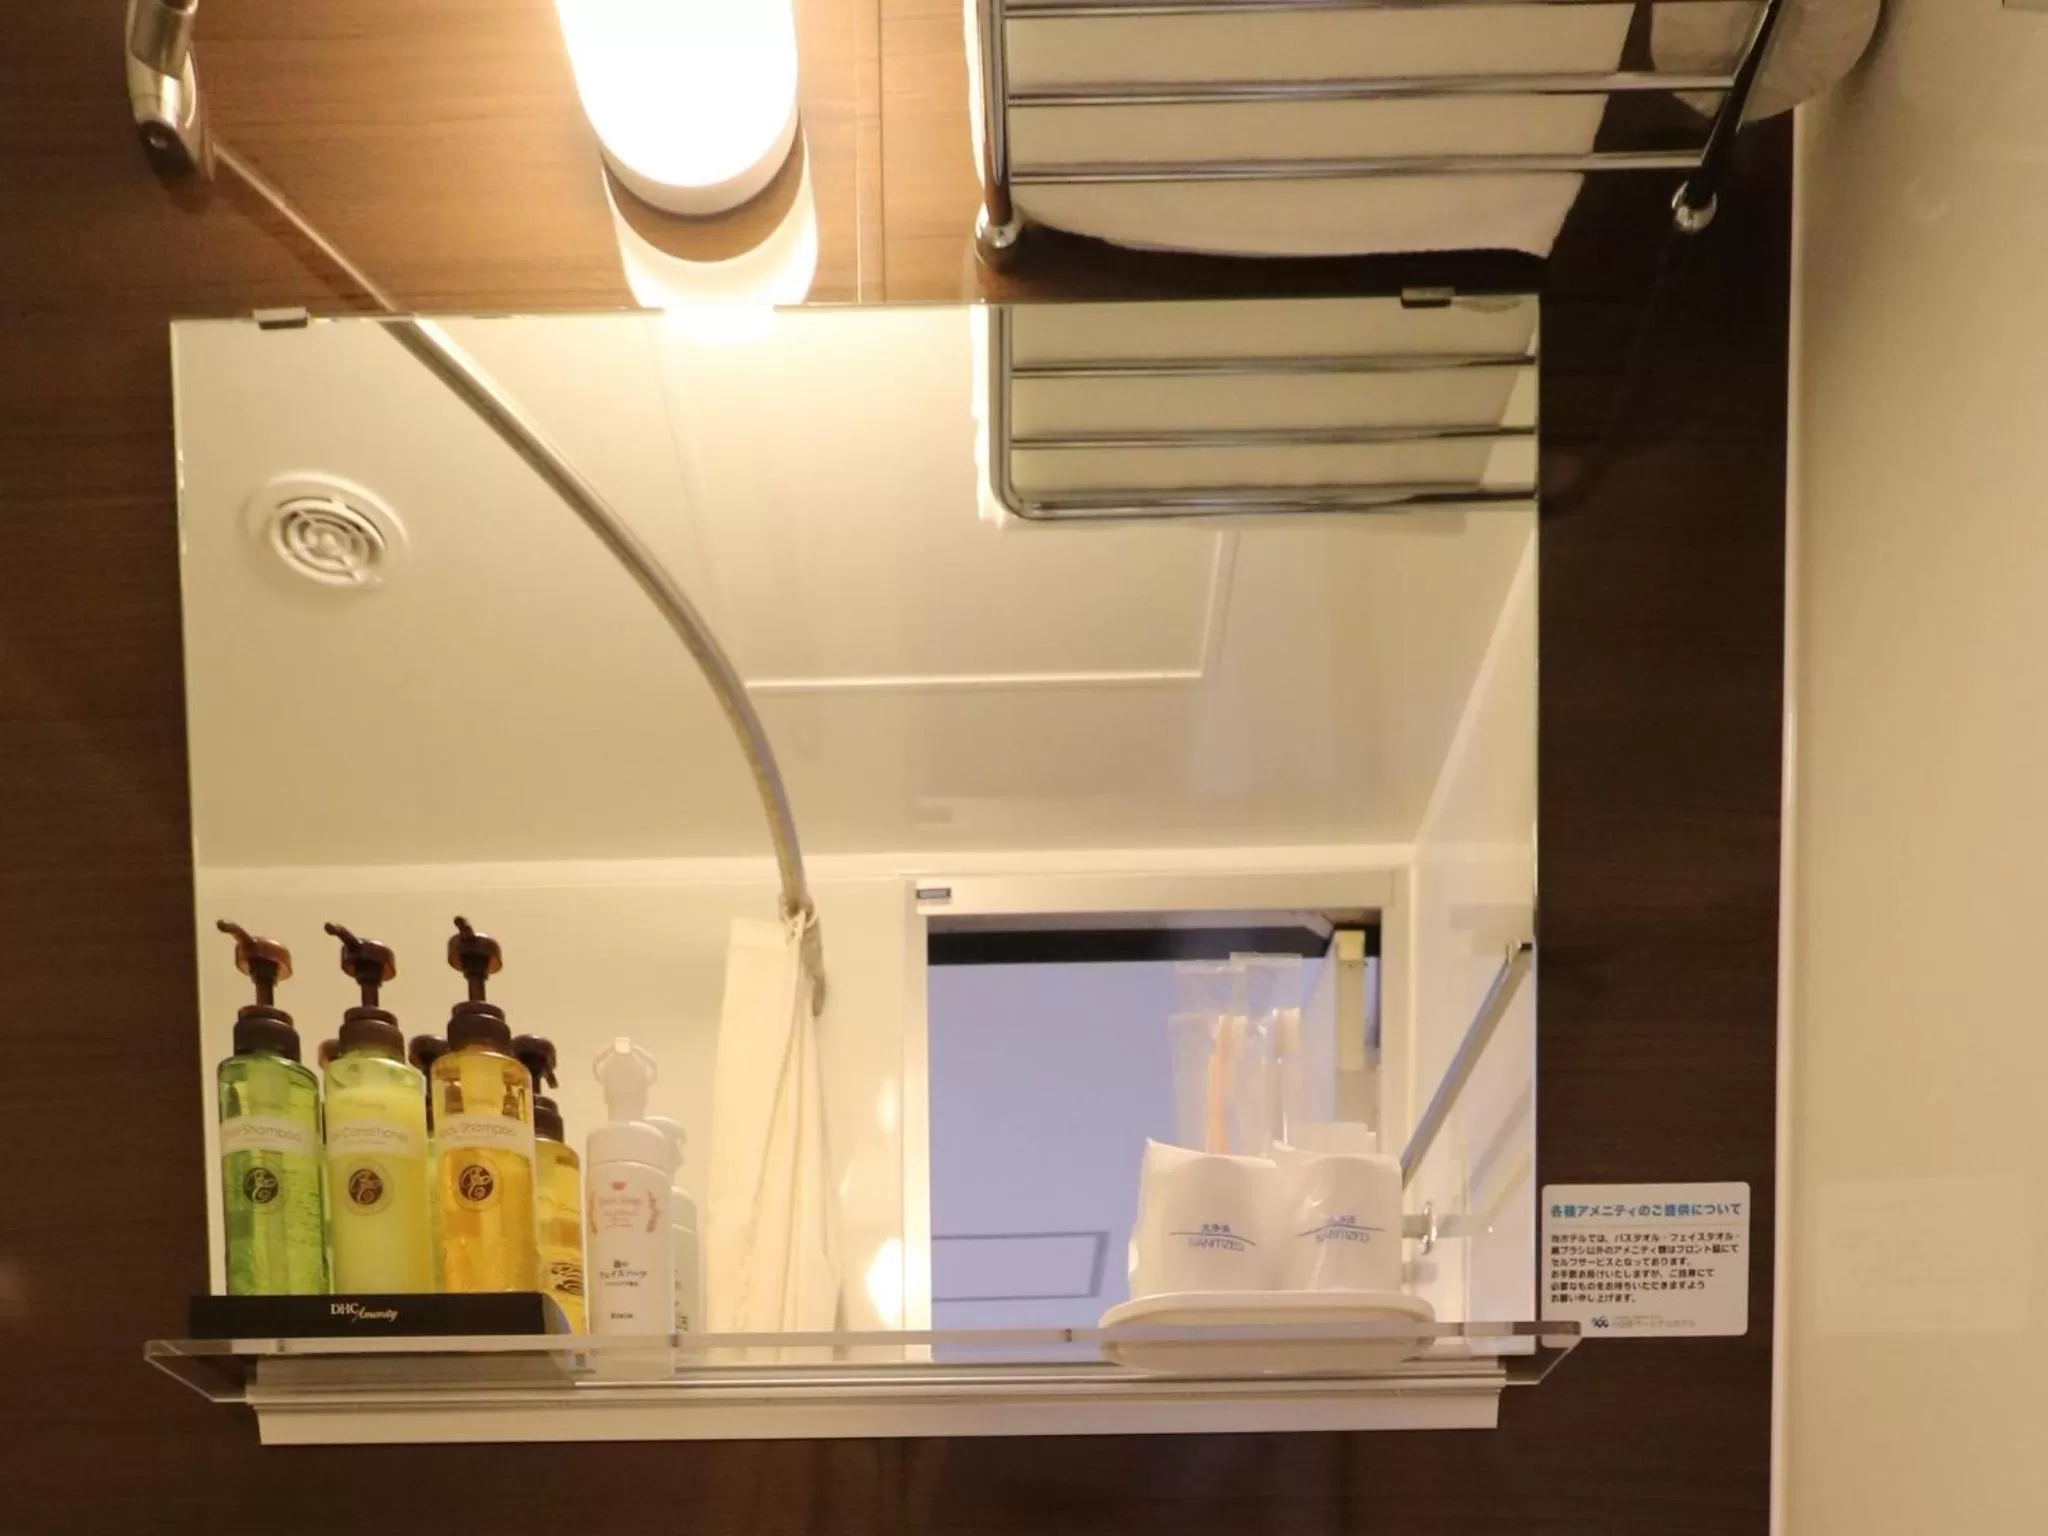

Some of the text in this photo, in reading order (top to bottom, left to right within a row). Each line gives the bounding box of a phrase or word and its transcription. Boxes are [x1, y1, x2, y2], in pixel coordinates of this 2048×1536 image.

[1550, 1202, 1742, 1218] 各種アメニティのご提供について
[331, 1302, 360, 1316] DHC
